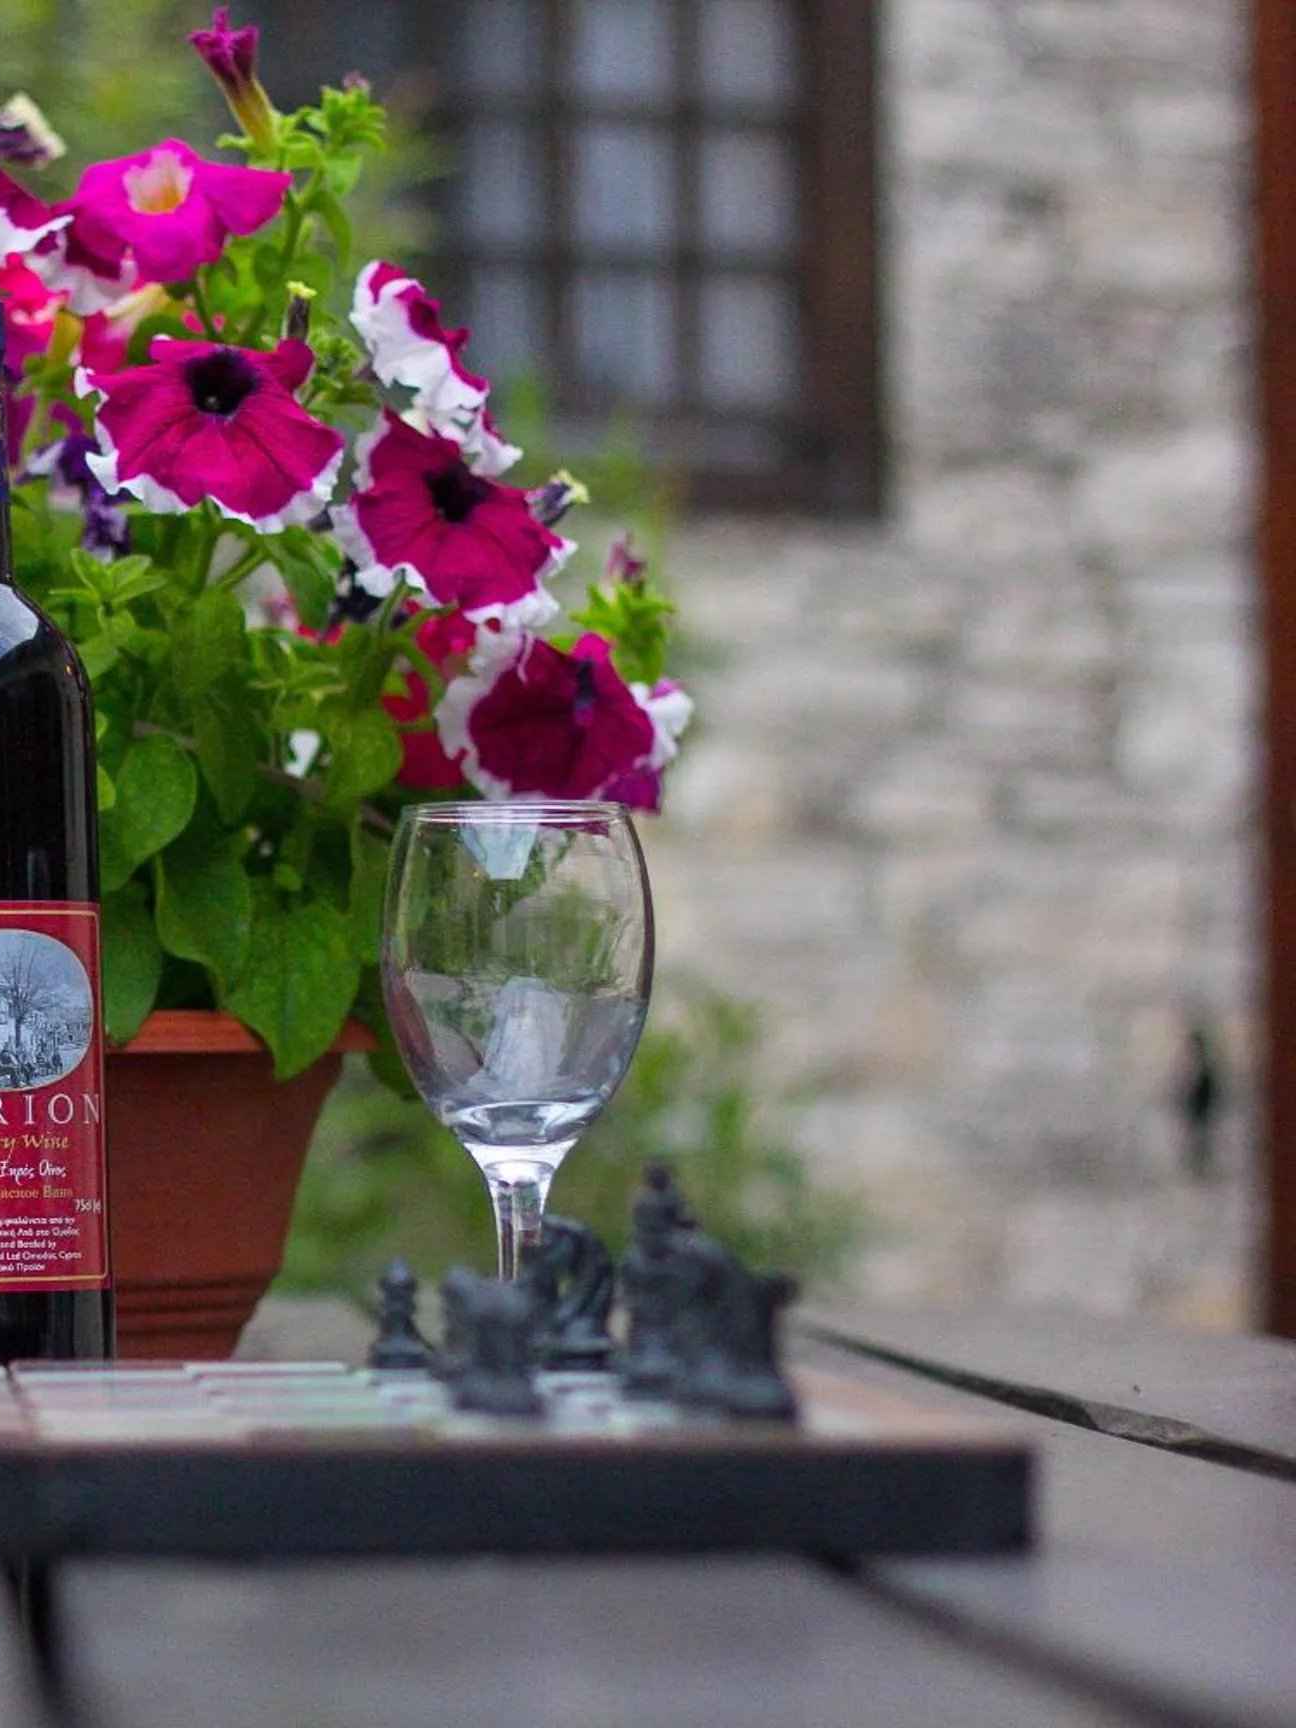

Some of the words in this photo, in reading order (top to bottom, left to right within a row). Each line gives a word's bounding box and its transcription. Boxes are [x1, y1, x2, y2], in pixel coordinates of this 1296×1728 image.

[22, 1131, 69, 1148] Wine
[17, 1239, 45, 1248] Bottled
[47, 1240, 56, 1250] by
